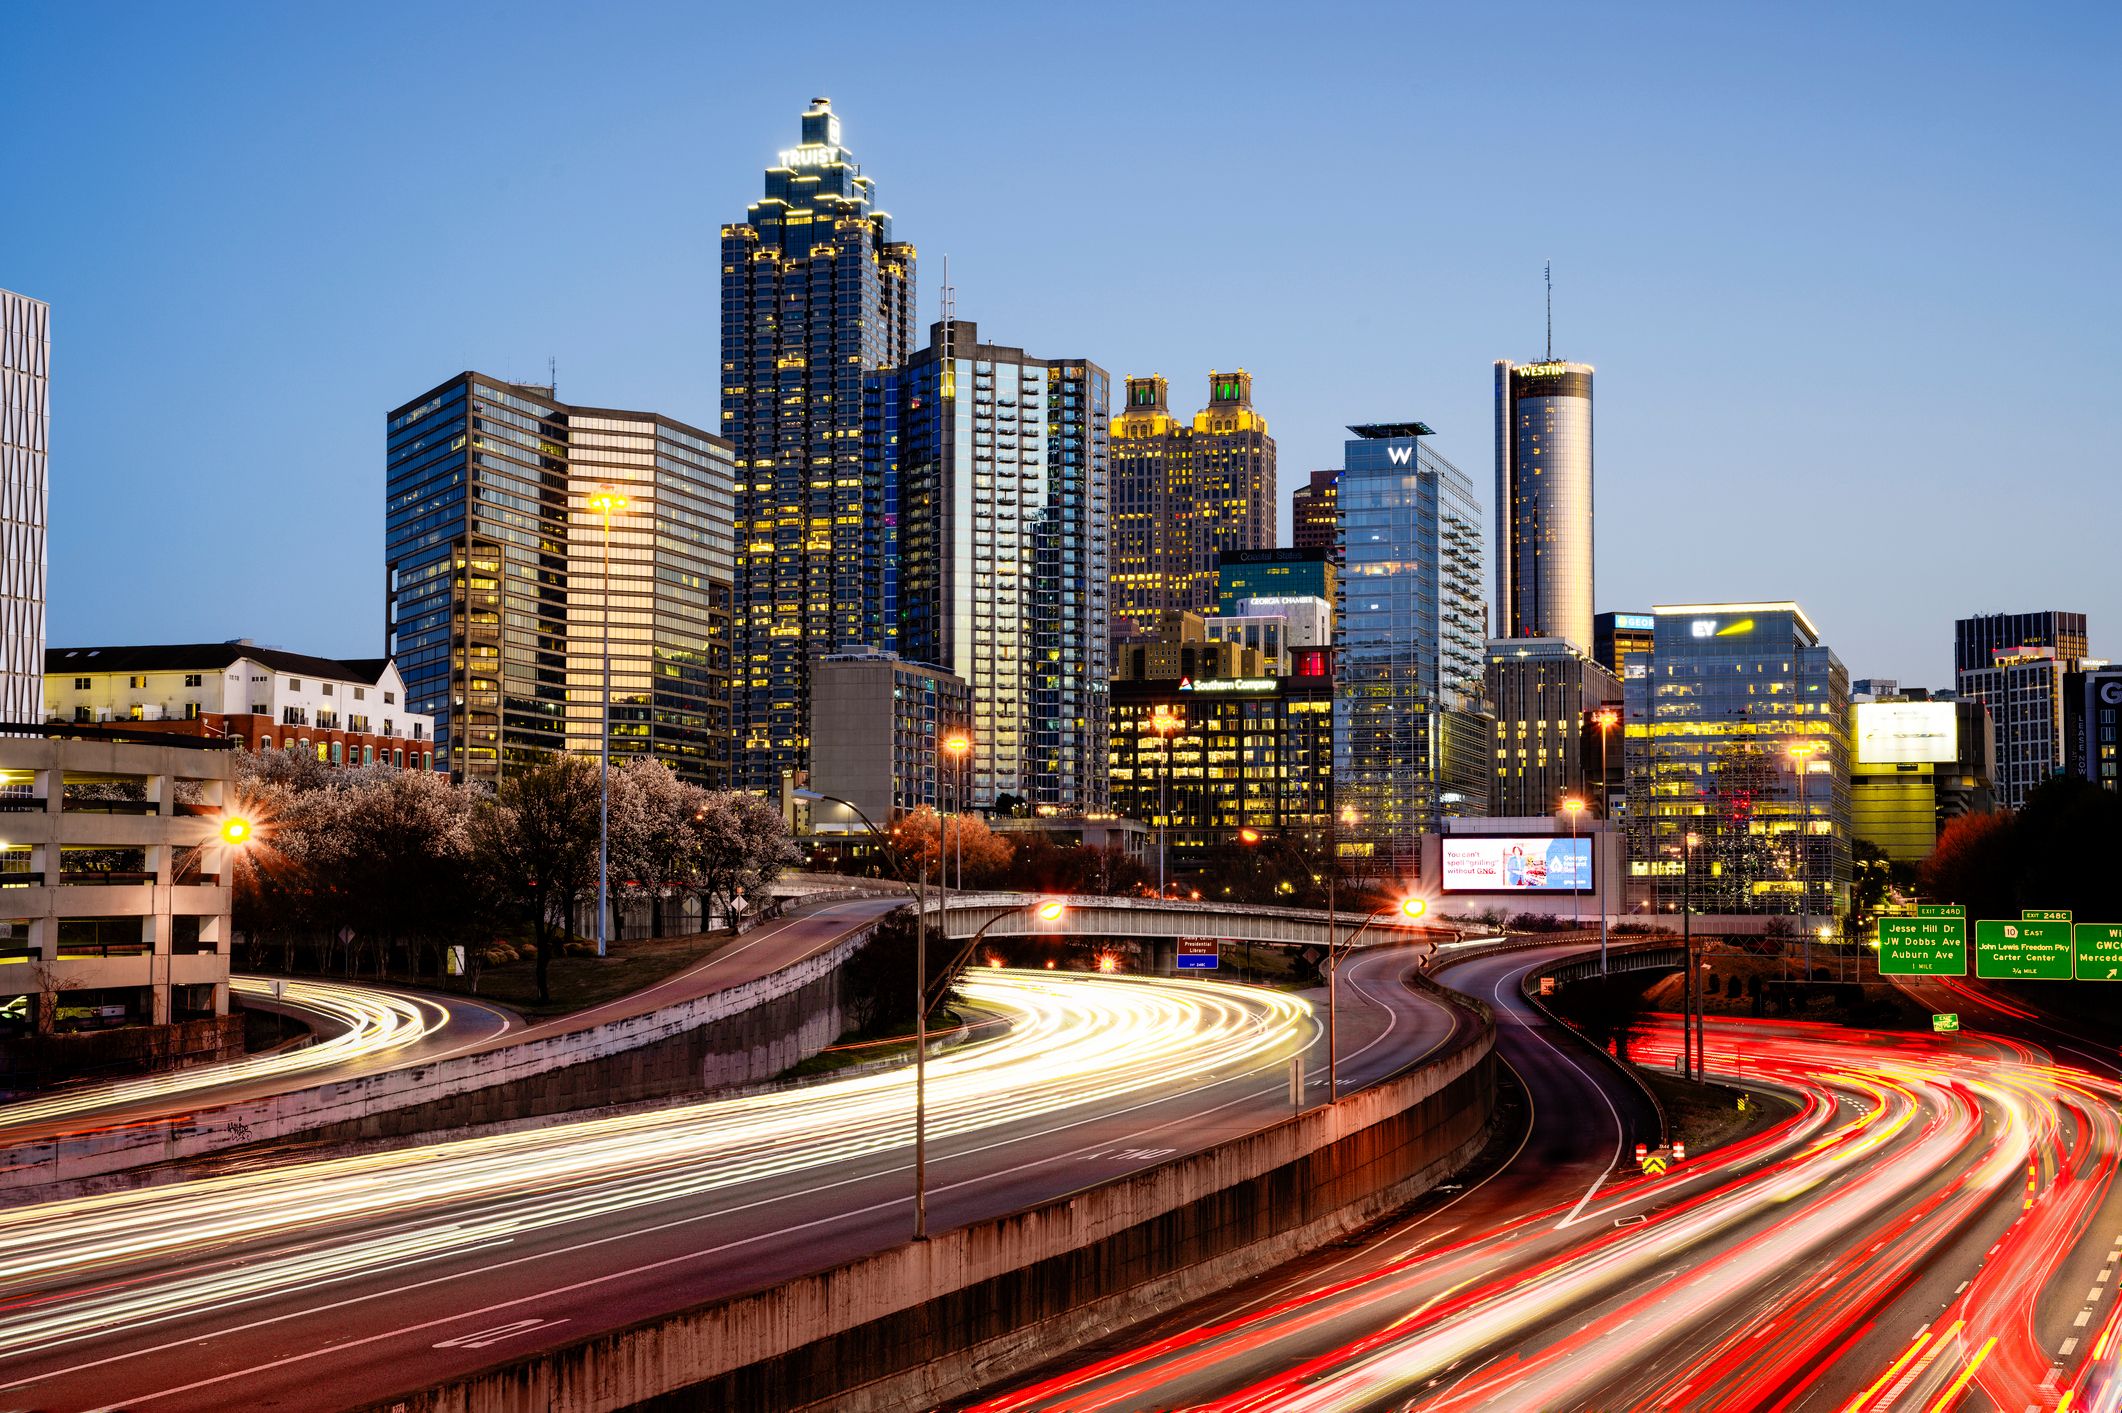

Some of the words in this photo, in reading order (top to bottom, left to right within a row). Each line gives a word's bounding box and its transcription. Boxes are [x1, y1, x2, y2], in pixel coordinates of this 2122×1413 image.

[779, 147, 838, 167] TRUIST
[1520, 365, 1566, 377] WESTIN
[1388, 447, 1412, 465] W
[1250, 597, 1280, 605] GEORGIA
[1281, 596, 1314, 604] CHAMBER
[1692, 620, 1717, 637] EY
[1193, 679, 1235, 691] Southern
[1235, 679, 1277, 691] Company
[2078, 755, 2086, 775] NOW
[1447, 859, 1465, 867] spell
[2043, 912, 2067, 920] 248C
[1889, 924, 1917, 933] Jesse
[1922, 924, 1938, 933] Hill
[1943, 924, 1955, 933] Dr
[2007, 928, 2016, 936] 10
[1883, 937, 1899, 946] JW
[1905, 937, 1936, 946] Dobbs
[1942, 937, 1961, 946] Ave
[2096, 941, 2122, 950] GWC
[1998, 943, 2019, 951] Lewis
[2021, 943, 2053, 951] Freedom
[2054, 943, 2070, 953] Pky
[1891, 950, 1929, 959] Auburn
[1935, 950, 1954, 959] Ave
[1993, 953, 2021, 961] Carter
[2025, 953, 2056, 961] Center
